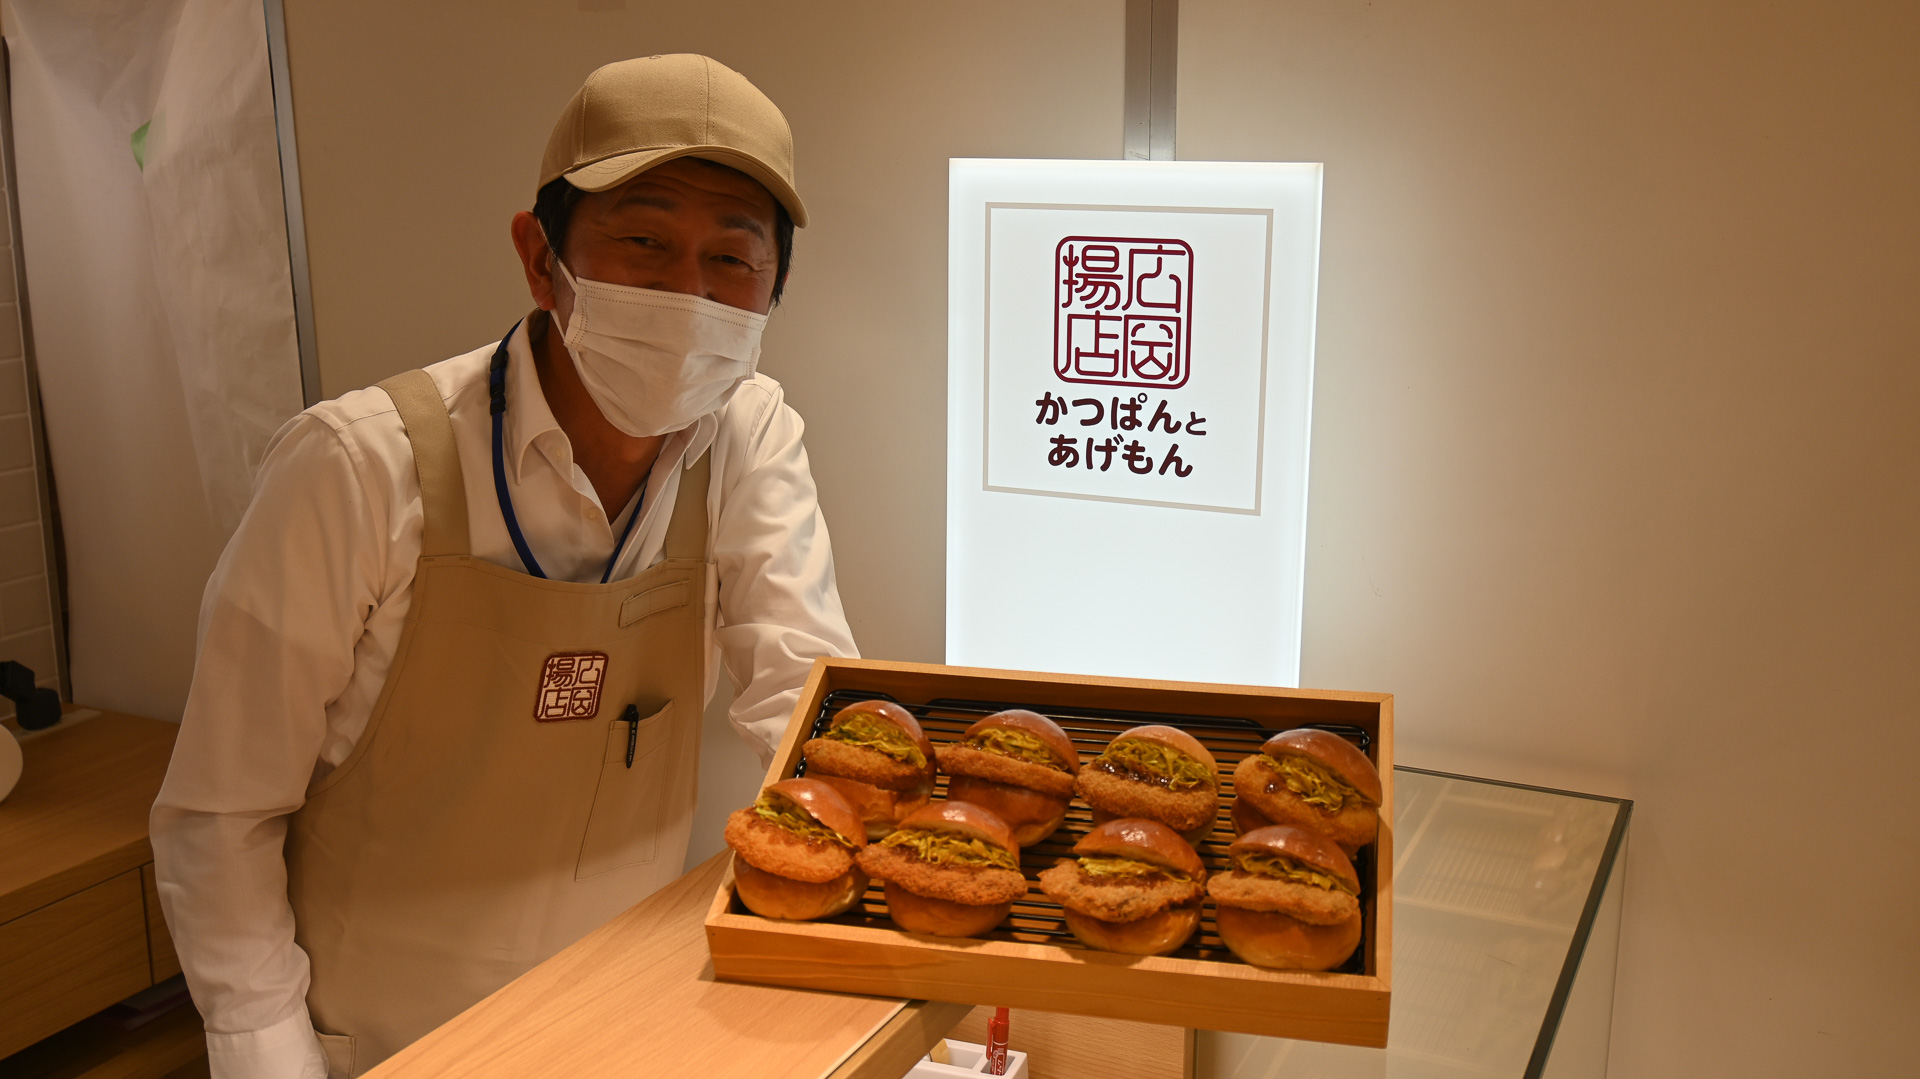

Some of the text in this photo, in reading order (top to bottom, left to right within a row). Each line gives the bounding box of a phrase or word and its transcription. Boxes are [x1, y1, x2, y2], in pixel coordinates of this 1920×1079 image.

[1035, 391, 1207, 436] かつぱんと
[1048, 433, 1193, 478] あげもん
